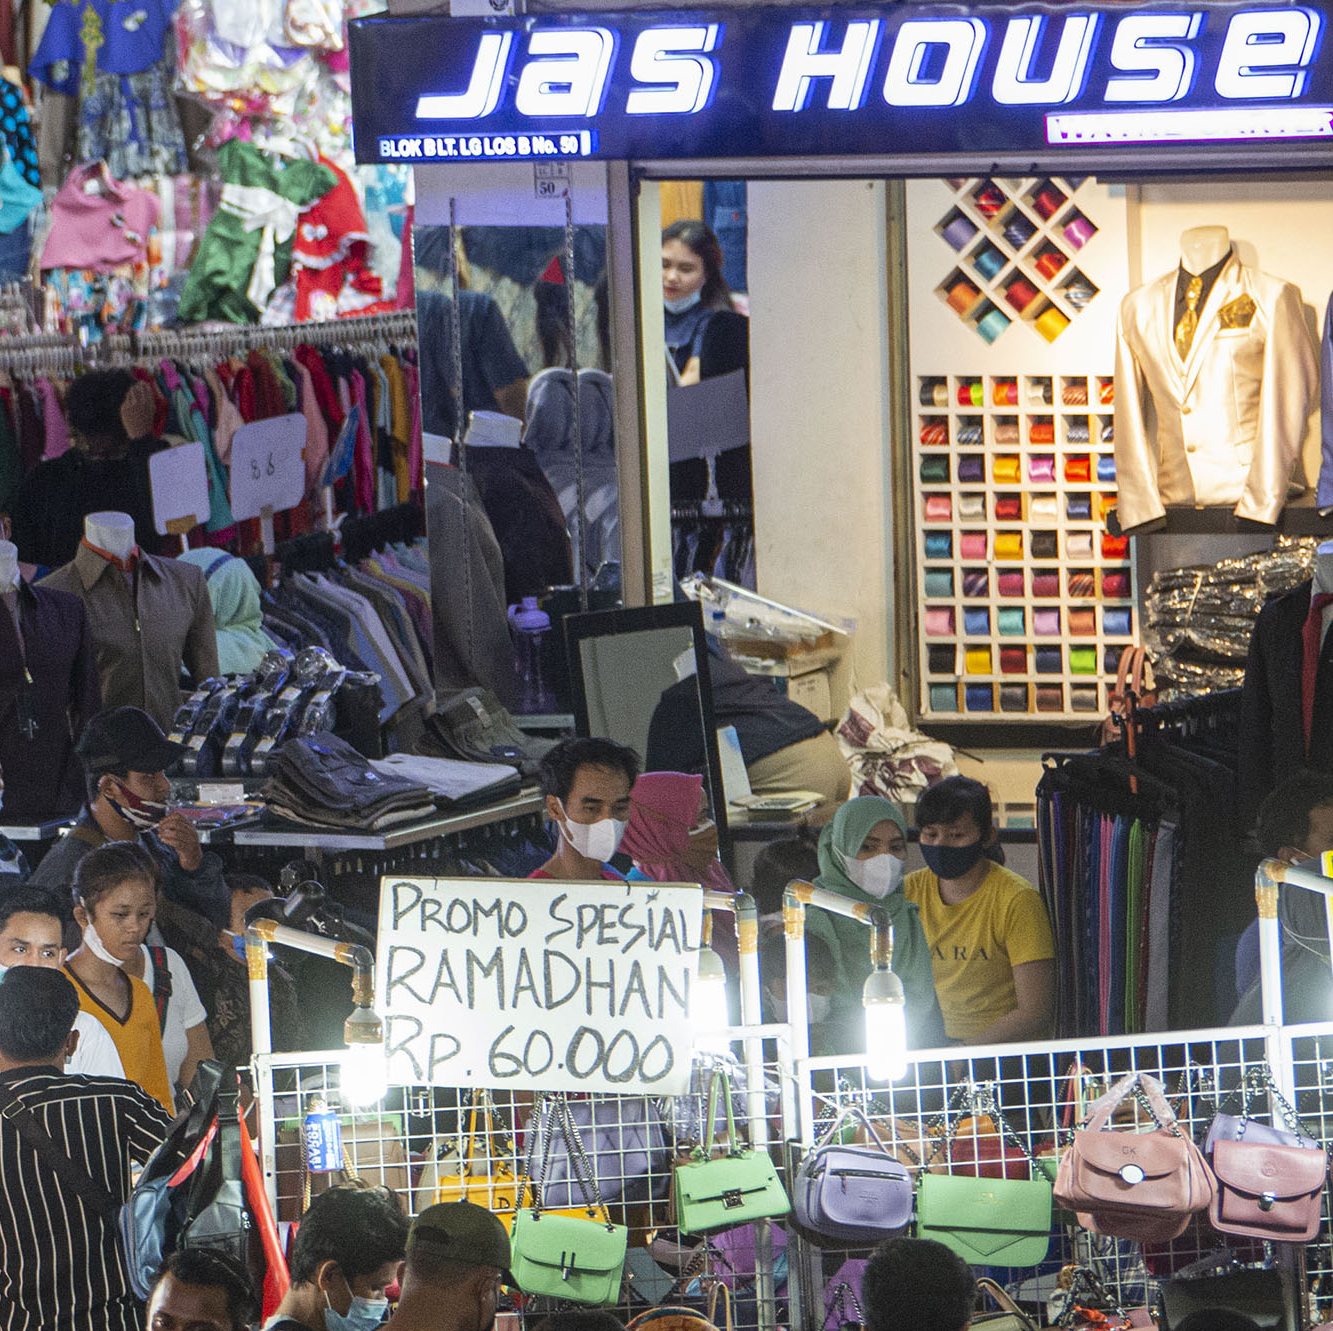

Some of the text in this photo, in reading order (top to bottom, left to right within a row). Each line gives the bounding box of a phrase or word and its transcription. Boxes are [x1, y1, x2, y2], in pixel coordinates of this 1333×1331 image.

[380, 136, 578, 157] BLOK B LT. LG LOS B No. 50
[539, 182, 555, 196] 50
[392, 882, 528, 939] PROMO
[934, 946, 989, 960] ARA
[385, 945, 690, 1020] RAMADHAN
[489, 1025, 674, 1084] 60.000
